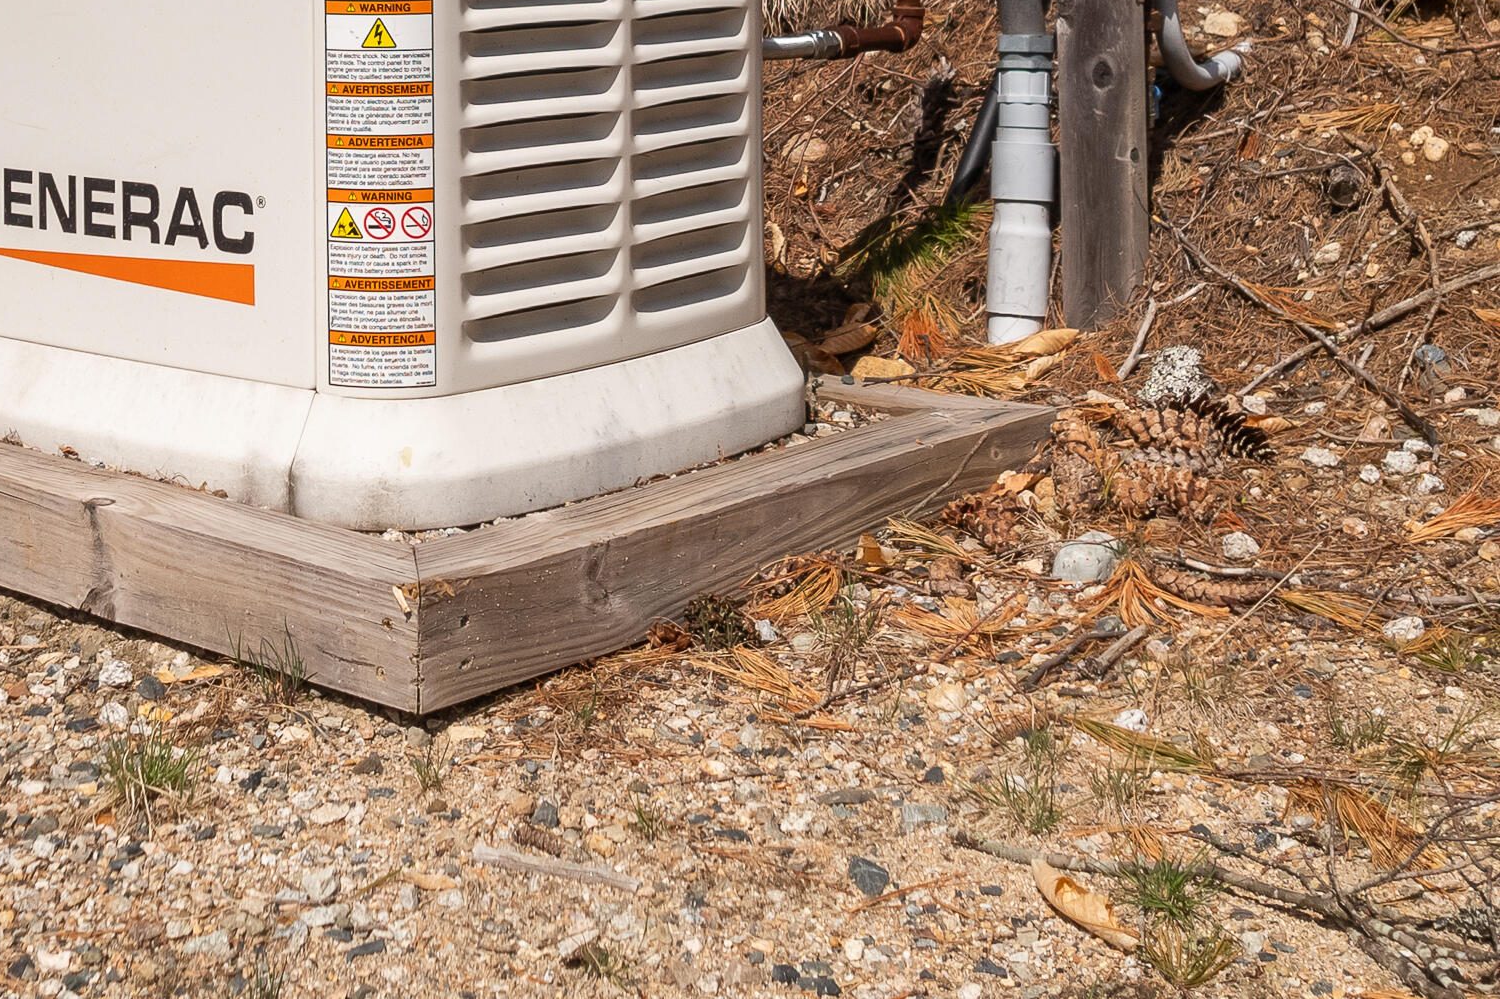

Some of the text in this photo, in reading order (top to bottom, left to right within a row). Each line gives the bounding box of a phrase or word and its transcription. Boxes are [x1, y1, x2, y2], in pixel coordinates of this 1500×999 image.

[360, 3, 411, 12] WARNING
[342, 84, 430, 94] AVERTISSEMENT
[348, 137, 424, 146] ADVERTENCIA
[361, 192, 412, 200] WARNING
[344, 279, 432, 289] AVERTISSEMENT
[350, 334, 426, 344] ADVERTENCIA
